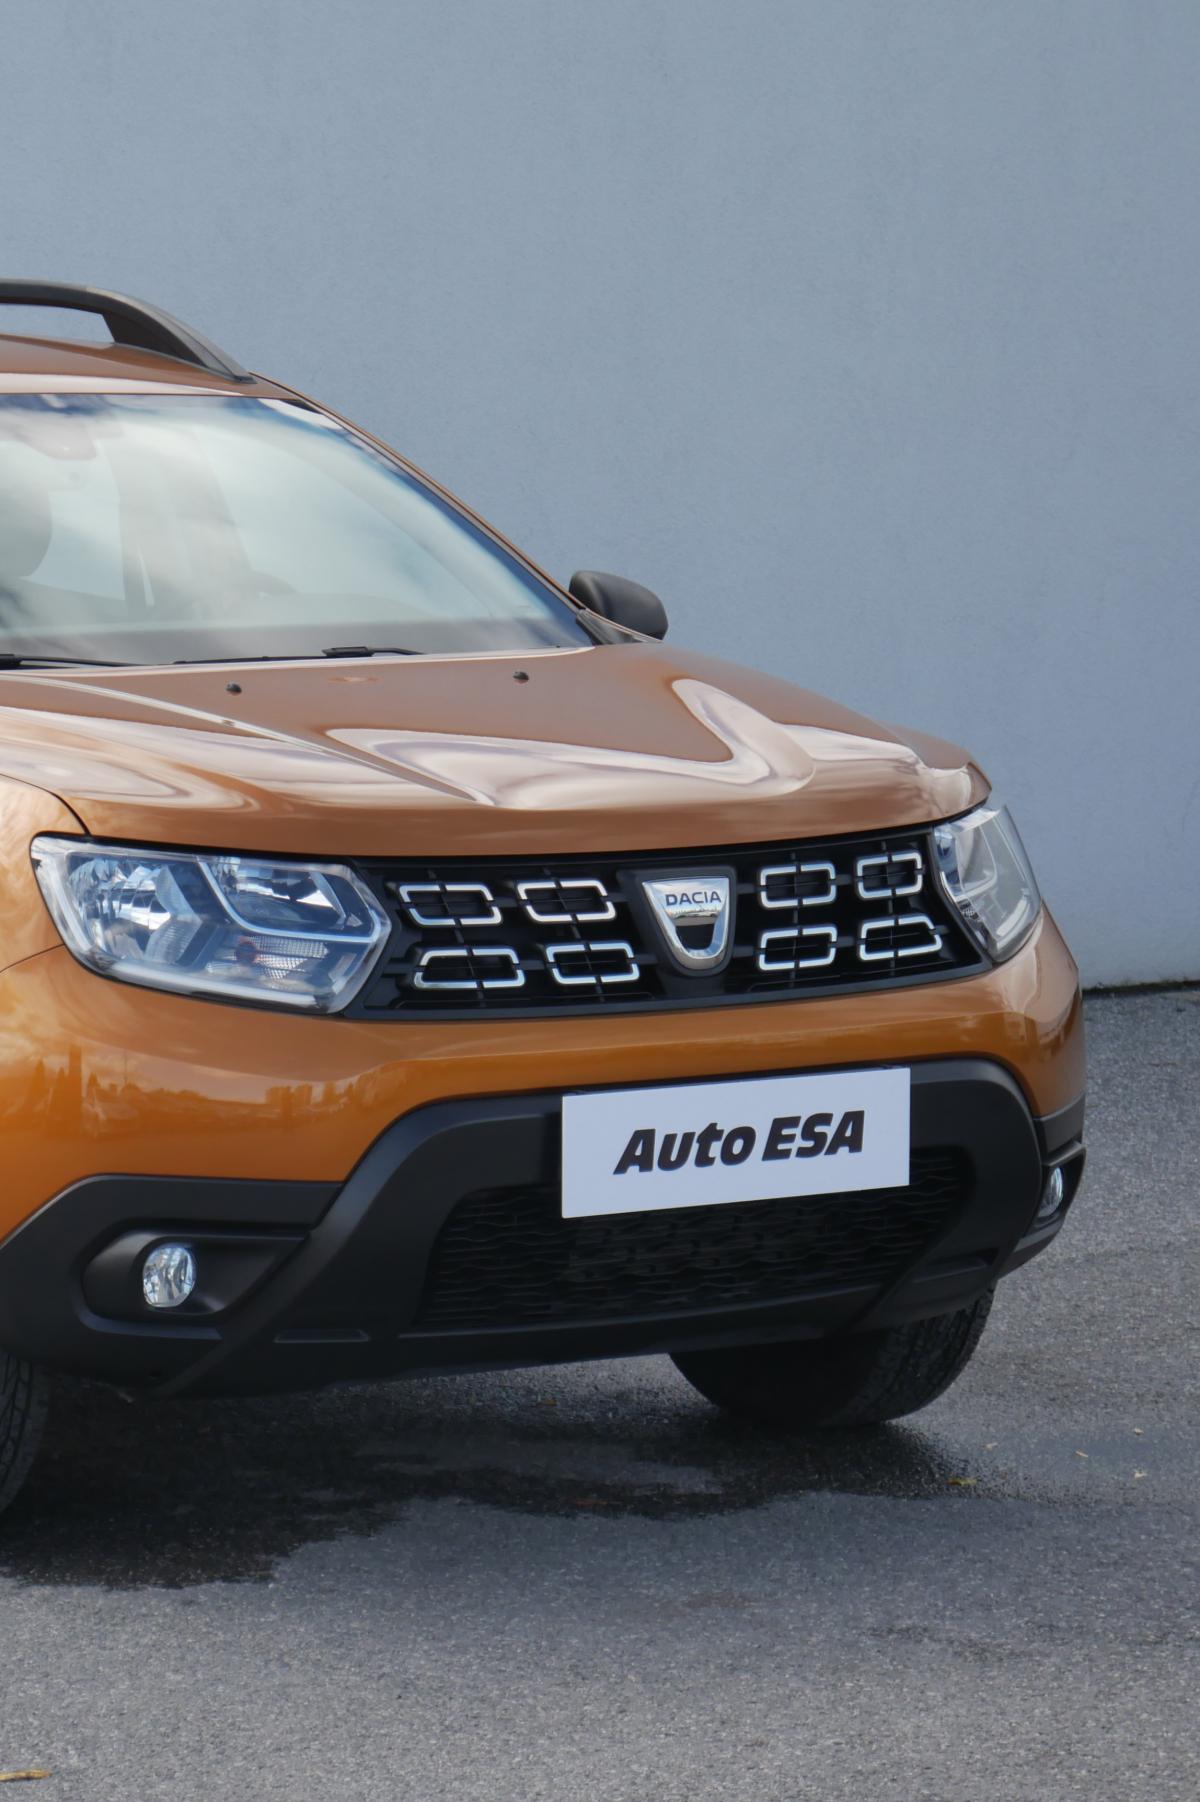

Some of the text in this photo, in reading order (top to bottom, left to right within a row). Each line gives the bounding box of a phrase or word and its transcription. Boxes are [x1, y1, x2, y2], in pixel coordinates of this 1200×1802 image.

[665, 891, 722, 906] DACIA
[612, 1109, 866, 1176] Auto ESA
